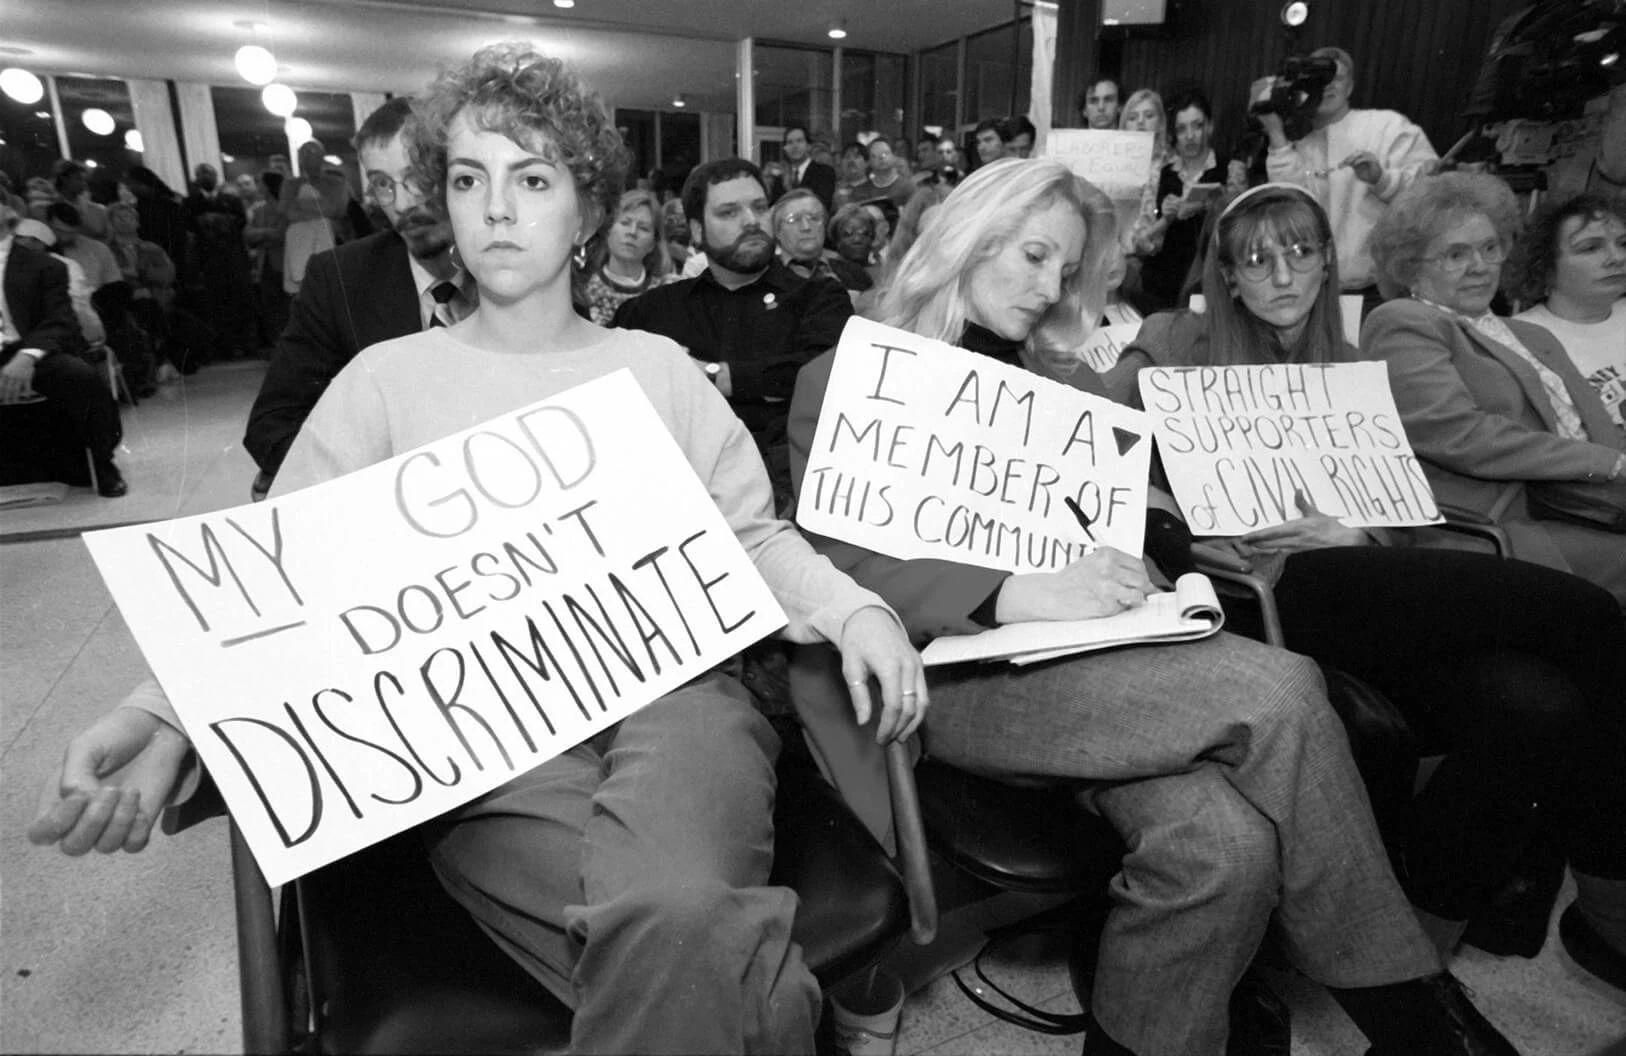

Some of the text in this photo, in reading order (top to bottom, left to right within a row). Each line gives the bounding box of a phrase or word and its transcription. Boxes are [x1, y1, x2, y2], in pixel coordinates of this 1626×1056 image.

[866, 343, 1096, 466] I AM A
[1150, 364, 1336, 415] STRAIGHT
[1164, 411, 1401, 453] SUPPORTERS
[147, 405, 598, 632] MY GOD
[812, 466, 894, 527] THIS
[830, 412, 1132, 527] MEMBER OF
[1191, 483, 1221, 530] of
[1319, 454, 1442, 521] RIGHTS
[339, 500, 607, 655] DOESN'T
[209, 530, 756, 849] DISCRIMINATE
